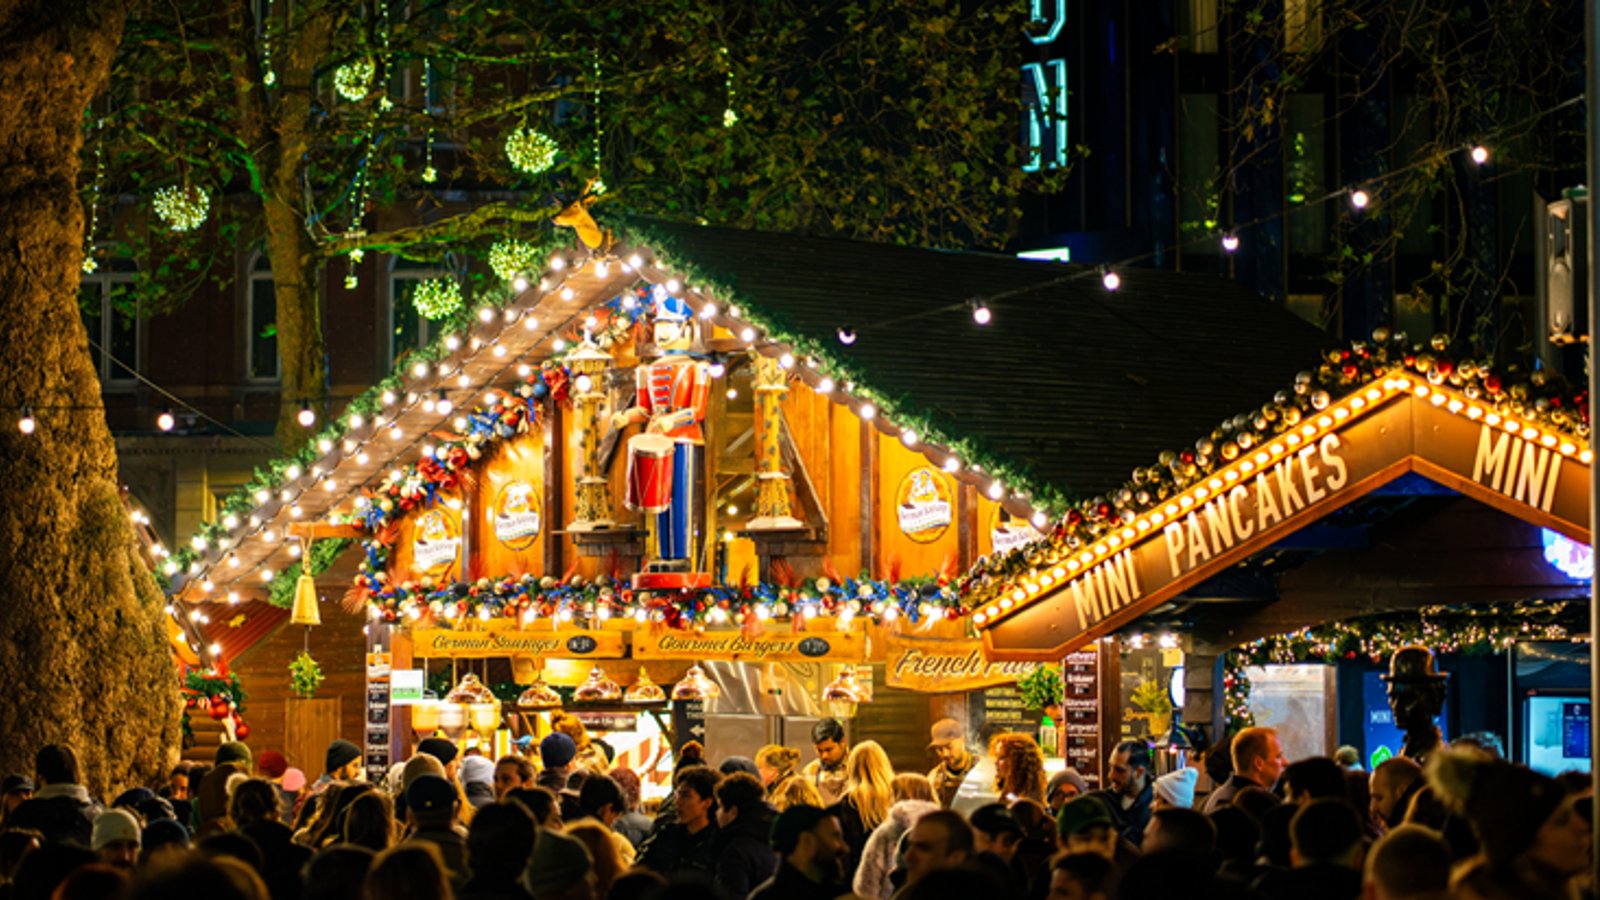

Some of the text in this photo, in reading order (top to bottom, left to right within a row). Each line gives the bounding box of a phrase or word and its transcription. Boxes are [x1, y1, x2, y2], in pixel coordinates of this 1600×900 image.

[1472, 424, 1562, 513] MINI
[1070, 432, 1348, 630] MINI PANCAKES
[432, 634, 490, 649] German
[491, 635, 562, 655] Sausages
[658, 634, 729, 650] Gourmet
[895, 648, 981, 678] French
